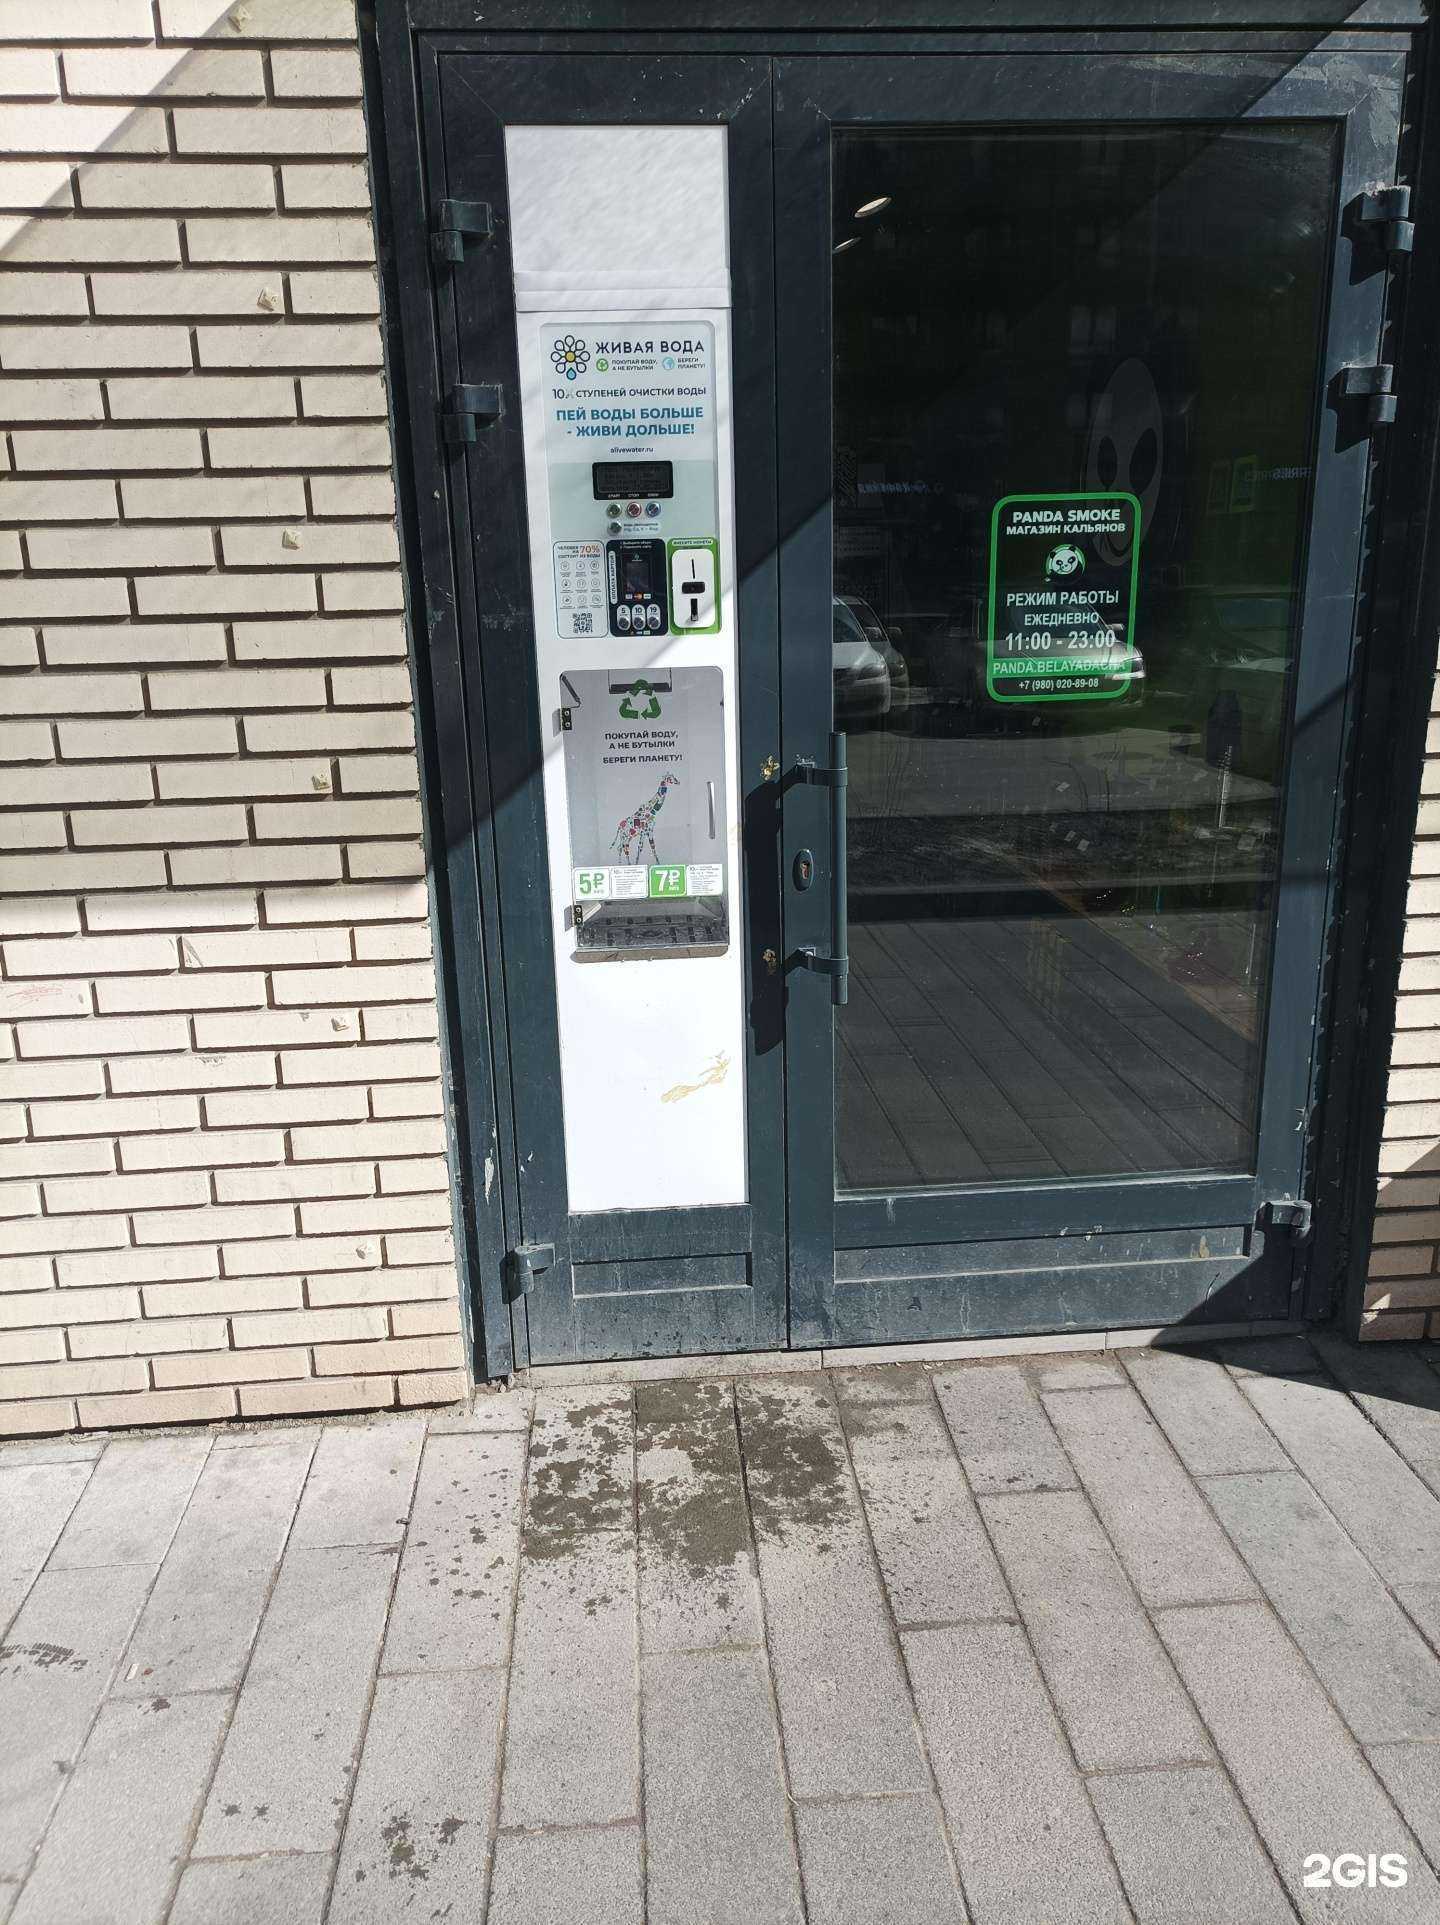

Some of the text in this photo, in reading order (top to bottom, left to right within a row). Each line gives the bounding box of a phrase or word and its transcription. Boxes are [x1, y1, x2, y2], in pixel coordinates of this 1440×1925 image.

[596, 340, 705, 354] ЖИВАЯ ВОДА
[576, 388, 626, 398] СТУПЕНЕЙ
[629, 388, 675, 397] ОЧИСТКИ
[677, 387, 707, 396] ВОДЫ
[556, 407, 704, 421] ПЕЙ ВОДЫ БОЛЬШЕ
[576, 425, 622, 437] ЖИВИ
[625, 424, 695, 438] ДОЛЬШЕ!
[610, 446, 654, 454] alivewater.ru
[1013, 509, 1120, 523] PANDA SMOKE
[1006, 523, 1126, 535] МАГАЗИН КАЛЬЯНОВ
[579, 545, 600, 554] 70%
[1007, 590, 1119, 606] РЕЖИМ РАБОТЫ
[1024, 612, 1100, 626] ЕЖЕДНЕВНО
[1005, 632, 1051, 651] 11:00
[1067, 630, 1116, 648] 23:00
[1019, 678, 1099, 691] +7 (980) 020-89-08
[605, 731, 679, 740] ПОКУПАЙ ВОДУ,
[603, 754, 683, 764] БЕРЕГИ ПЛАНЕТУ!
